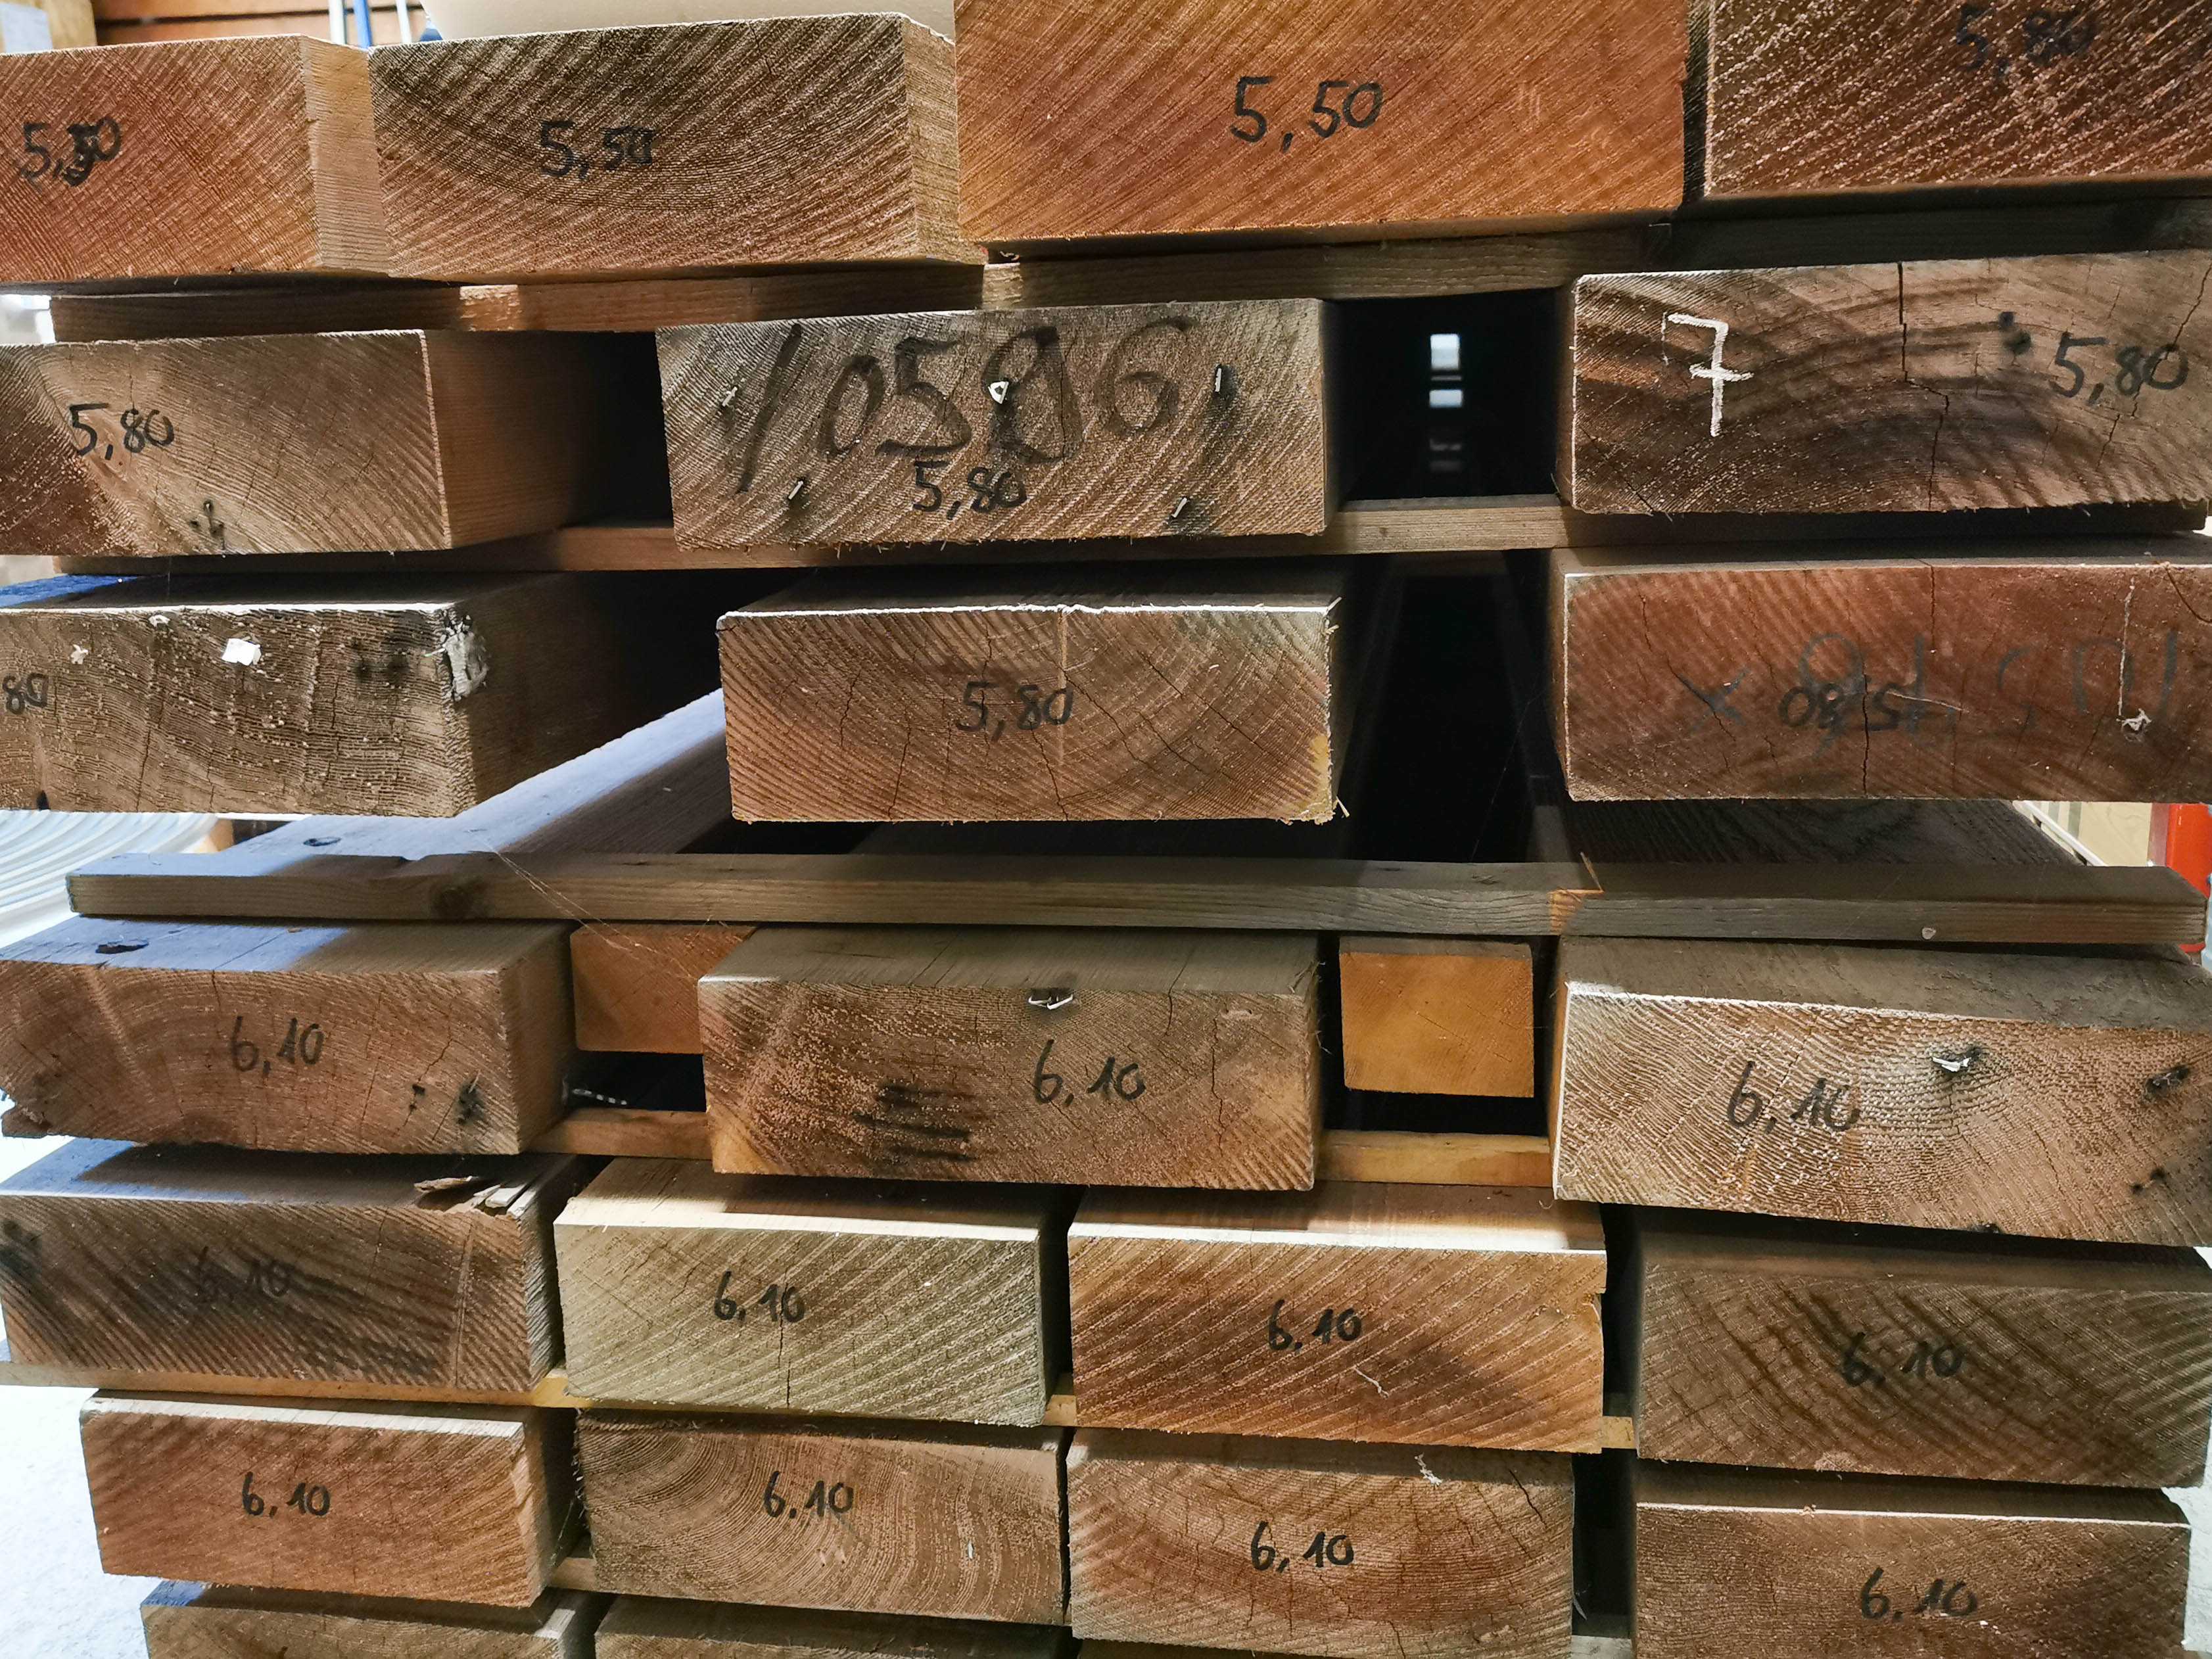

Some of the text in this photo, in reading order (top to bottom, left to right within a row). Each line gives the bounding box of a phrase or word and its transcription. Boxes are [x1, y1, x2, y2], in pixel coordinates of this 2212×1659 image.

[1229, 76, 1383, 153] 5,50
[2050, 332, 2189, 406] 5,80
[70, 402, 175, 460] 5,80
[911, 460, 1027, 521] 5,80
[956, 680, 1074, 741] 5,80
[229, 1016, 323, 1079] 6,10
[1032, 1039, 1146, 1108] 6,10
[1728, 1061, 1862, 1133] 6,10
[715, 1270, 806, 1324] 6,10
[1267, 1299, 1362, 1351] 6,10
[1841, 1332, 1963, 1387] 6,10
[241, 1471, 330, 1517] 6,10
[1250, 1521, 1355, 1574] 6,10
[1859, 1566, 1980, 1622] 6,10
